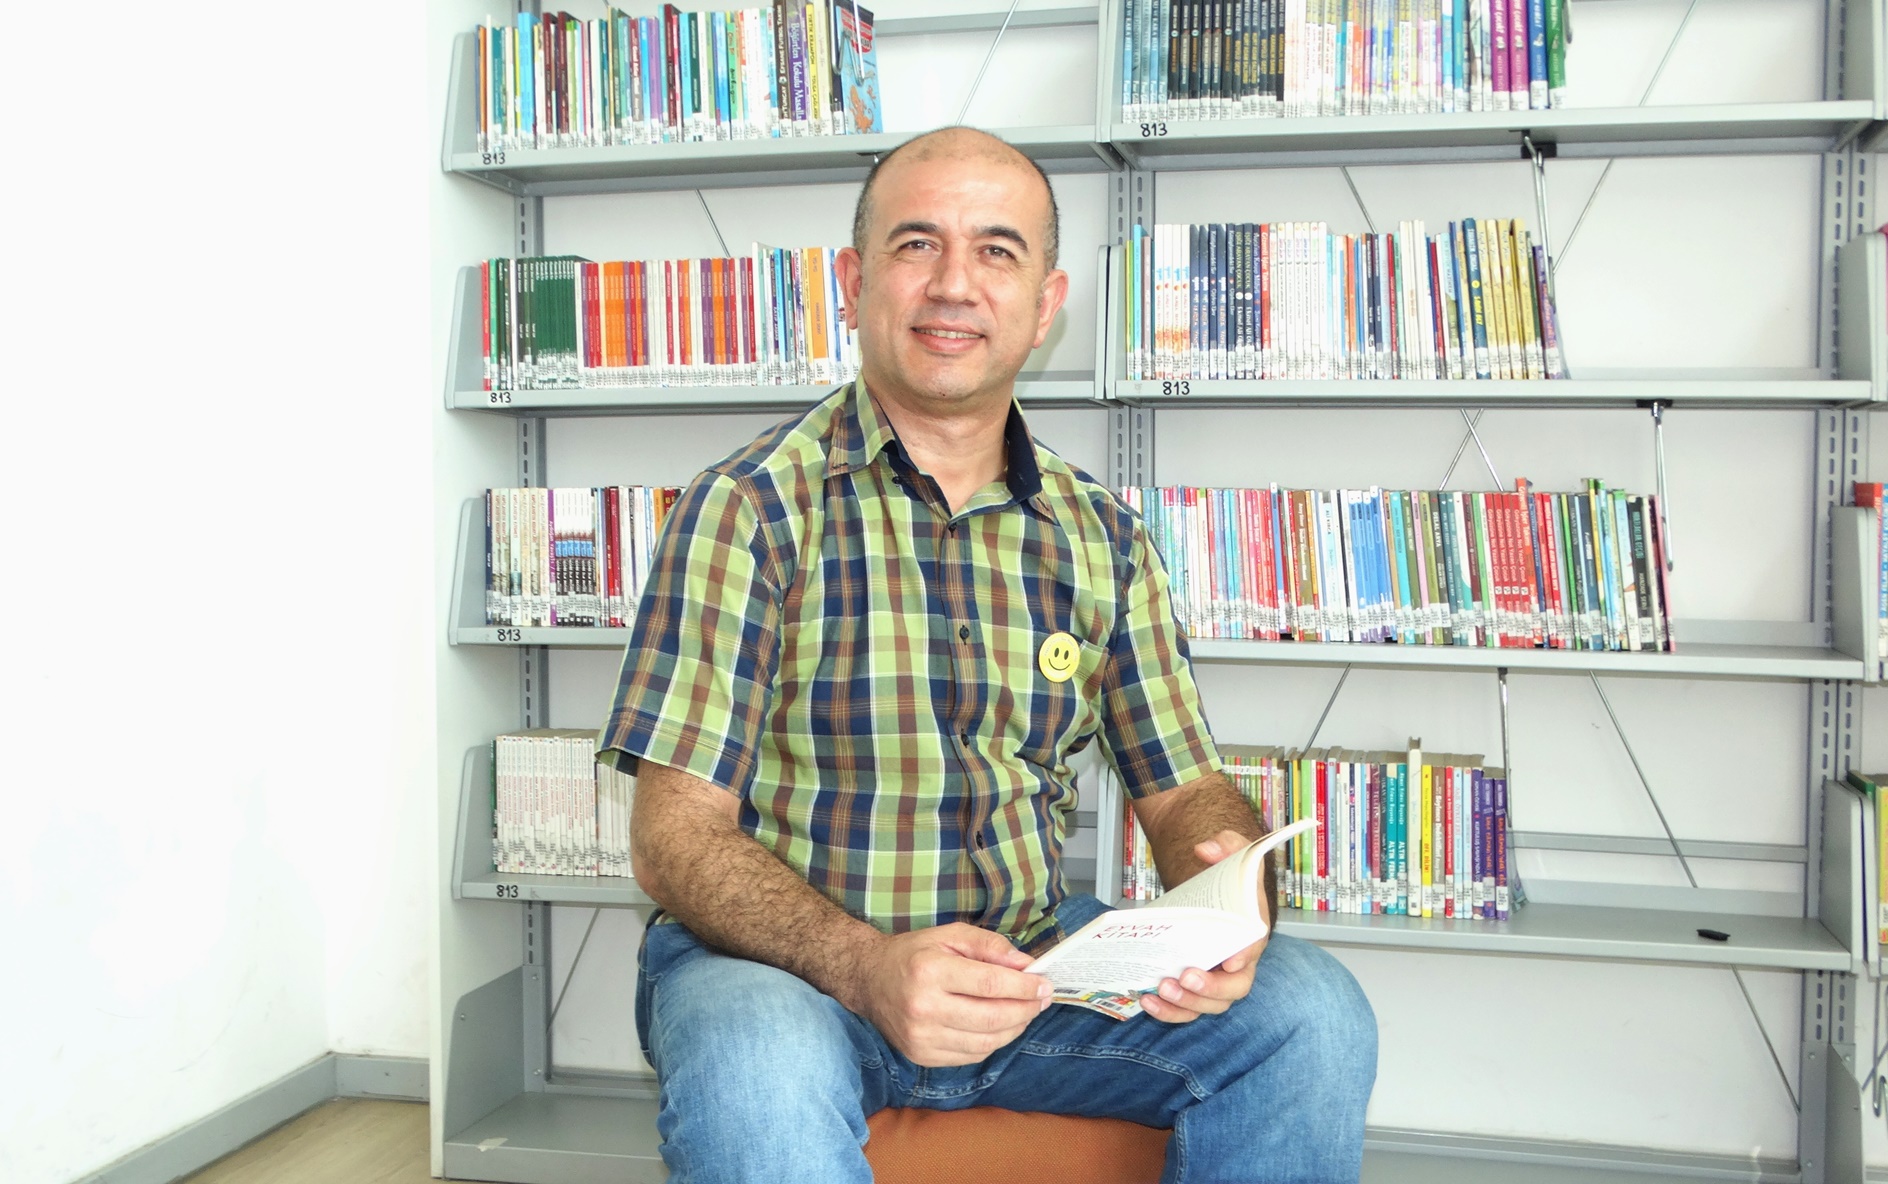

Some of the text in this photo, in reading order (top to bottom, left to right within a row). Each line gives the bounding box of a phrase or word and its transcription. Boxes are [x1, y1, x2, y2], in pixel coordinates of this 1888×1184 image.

[793, 61, 803, 88] Kokulu
[1141, 123, 1167, 137] 813
[482, 151, 505, 165] 813
[1235, 268, 1243, 290] ÇOCUK
[1244, 268, 1252, 290] ÇOCUK
[1163, 381, 1191, 396] 813
[490, 391, 512, 404] 813
[1432, 511, 1442, 548] DELAL ARYA
[1492, 565, 1500, 582] Çocuk
[1502, 565, 1510, 582] Çocuk
[1510, 565, 1518, 582] Çocuk
[1519, 565, 1527, 582] Çocuk
[497, 628, 522, 643] 813
[1398, 841, 1406, 862] ALTIN
[496, 884, 519, 898] 813
